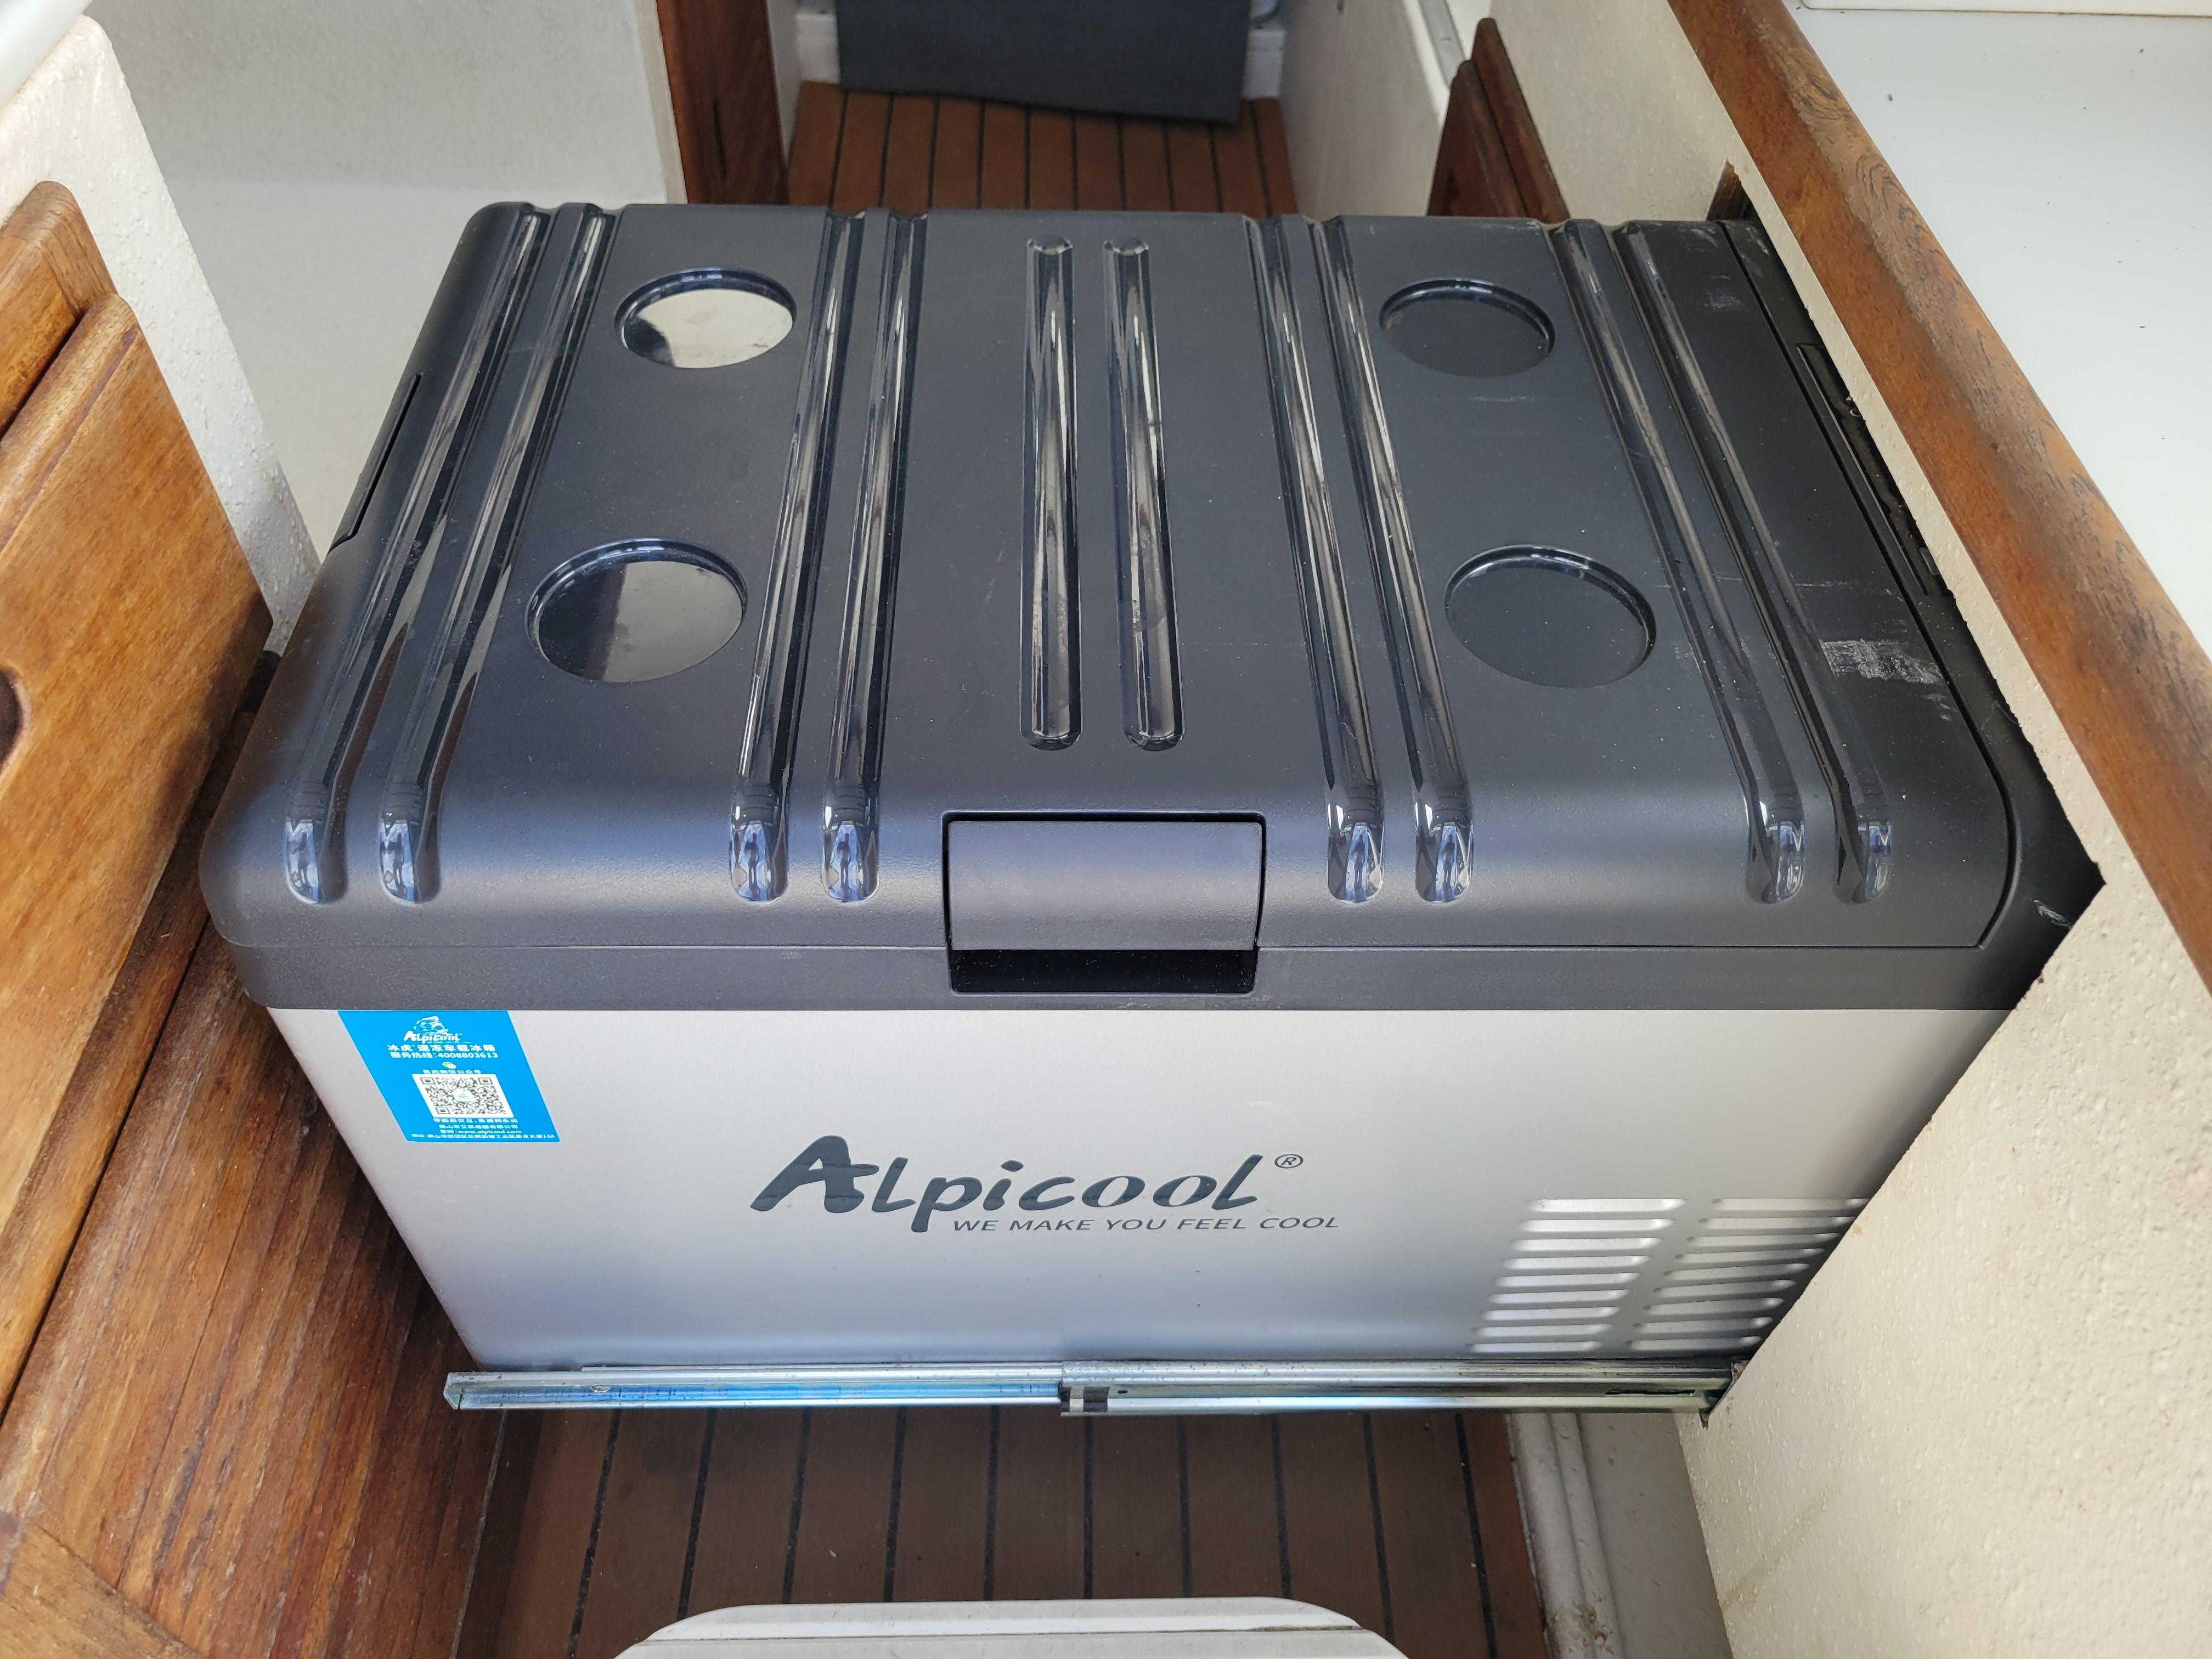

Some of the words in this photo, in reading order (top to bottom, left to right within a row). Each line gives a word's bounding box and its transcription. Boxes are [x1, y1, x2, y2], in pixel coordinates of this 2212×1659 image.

[953, 1220, 1000, 1231] WE
[1008, 1219, 1095, 1231] MAKE
[1105, 1219, 1167, 1231] YOU
[1176, 1218, 1246, 1230] FEEL
[1259, 1217, 1339, 1229] COOL
